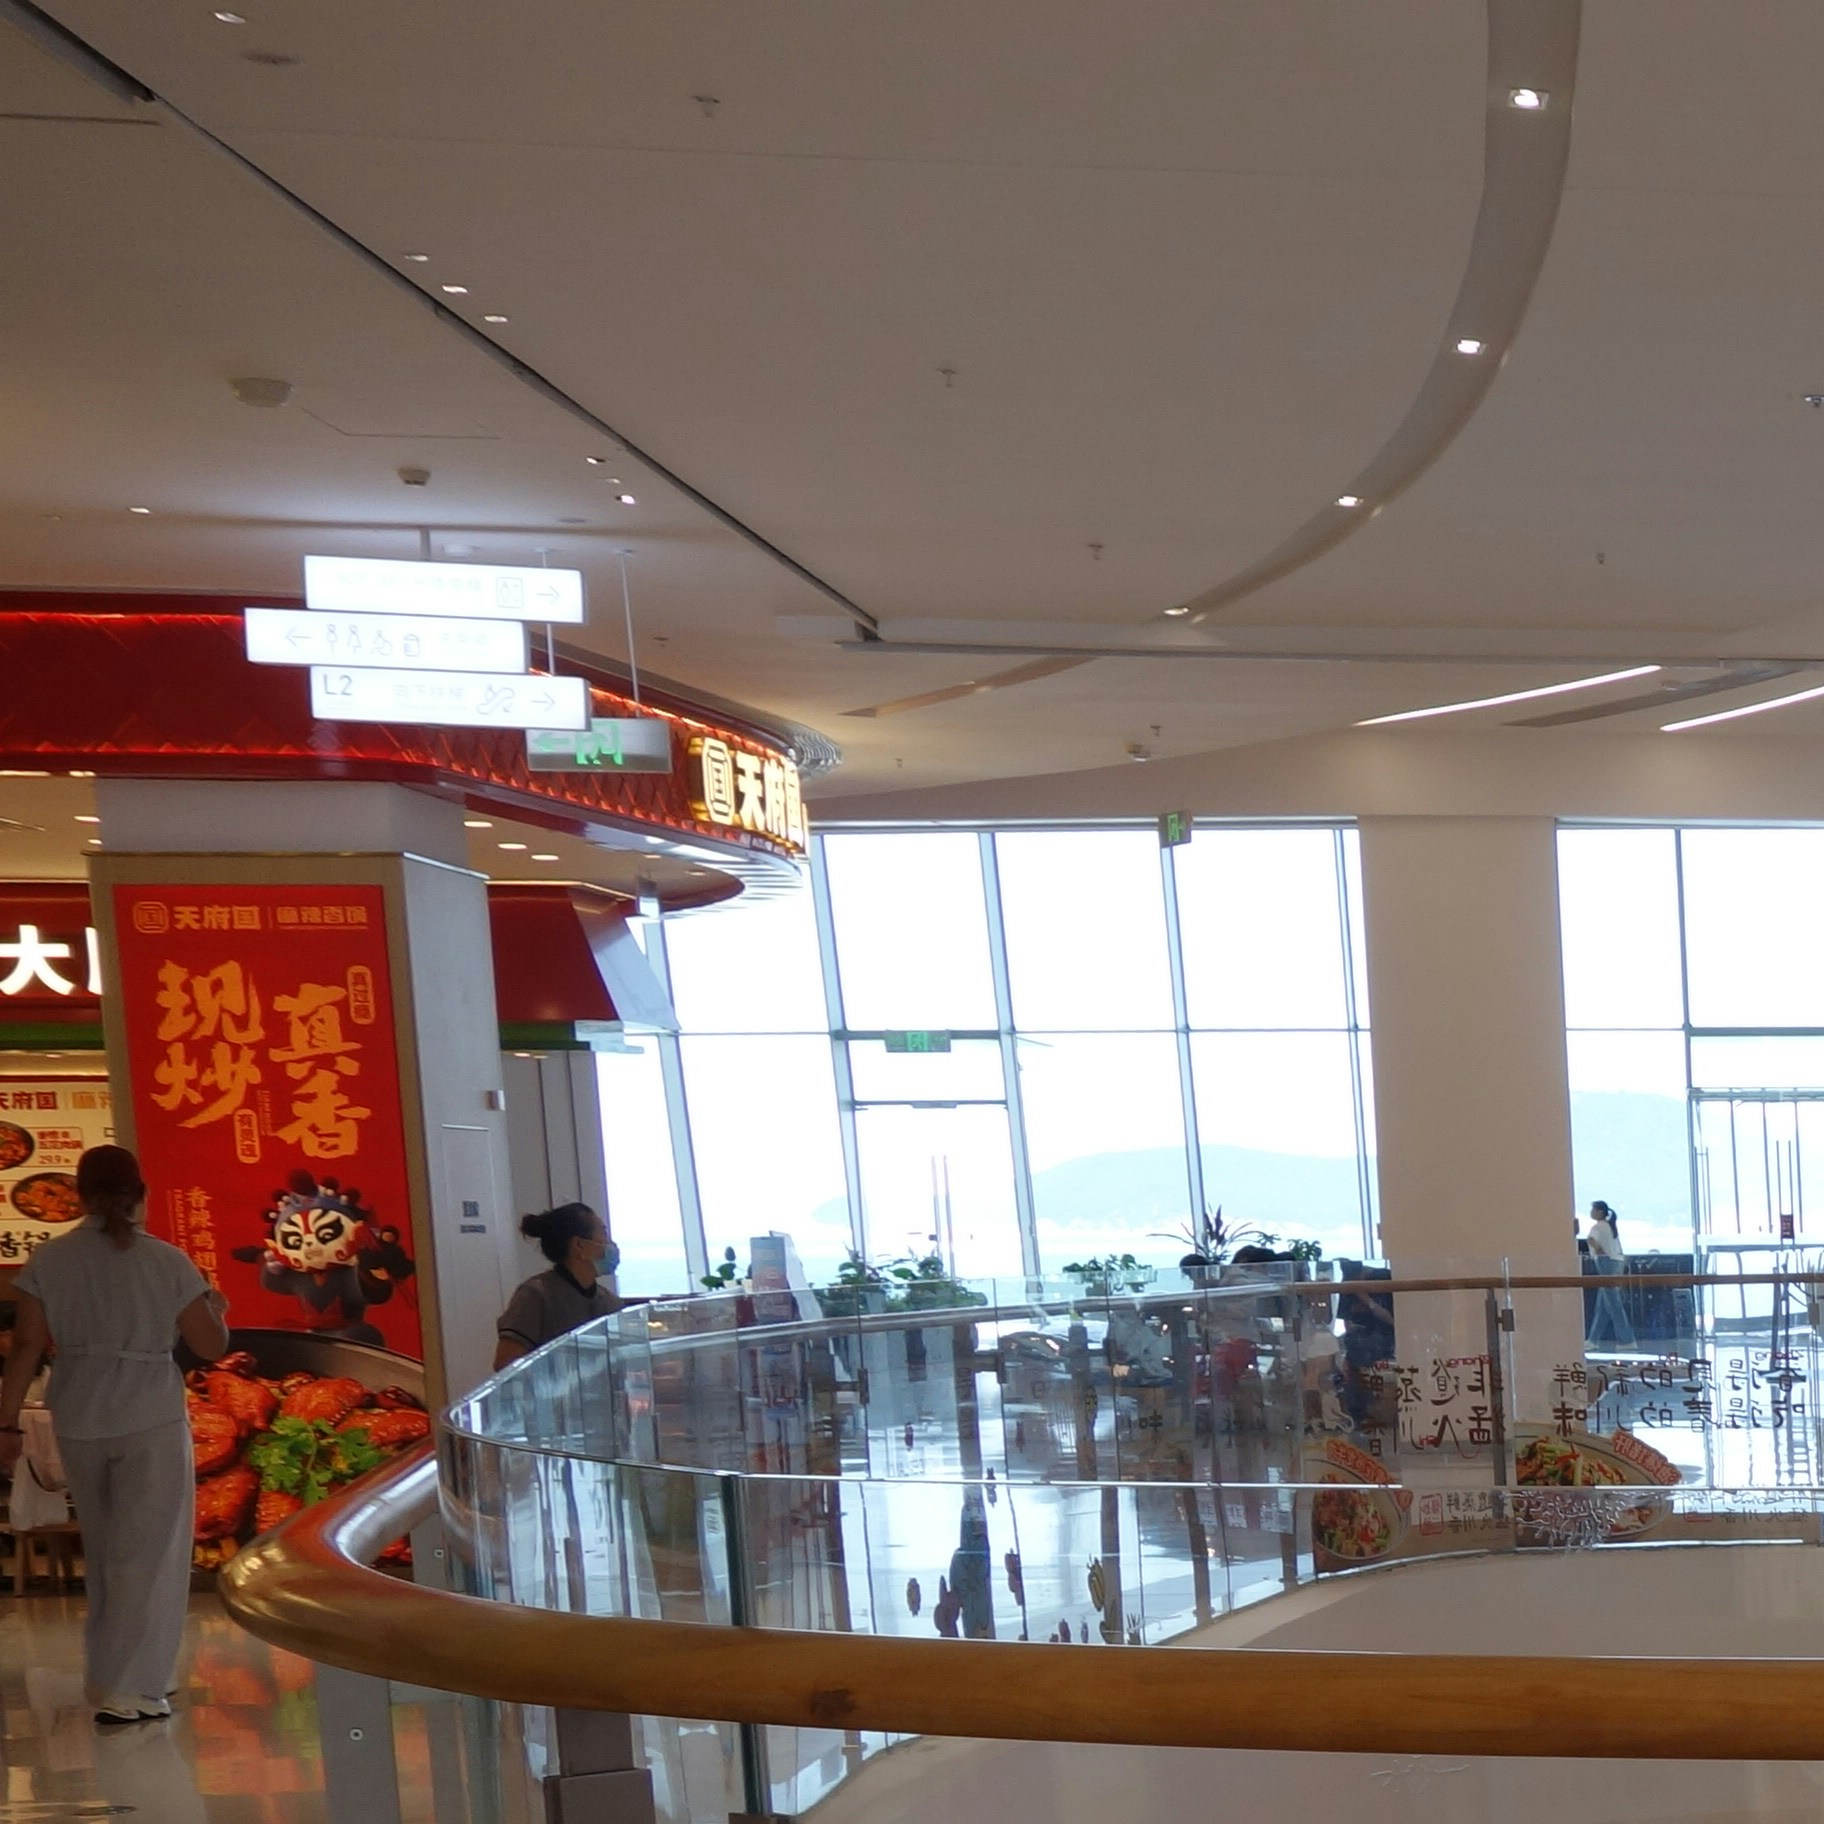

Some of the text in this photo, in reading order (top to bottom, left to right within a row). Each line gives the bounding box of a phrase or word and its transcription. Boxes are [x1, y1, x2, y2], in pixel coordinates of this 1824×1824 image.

[322, 674, 353, 697] L2
[735, 751, 804, 850] 天府国
[173, 905, 262, 931] 天府国
